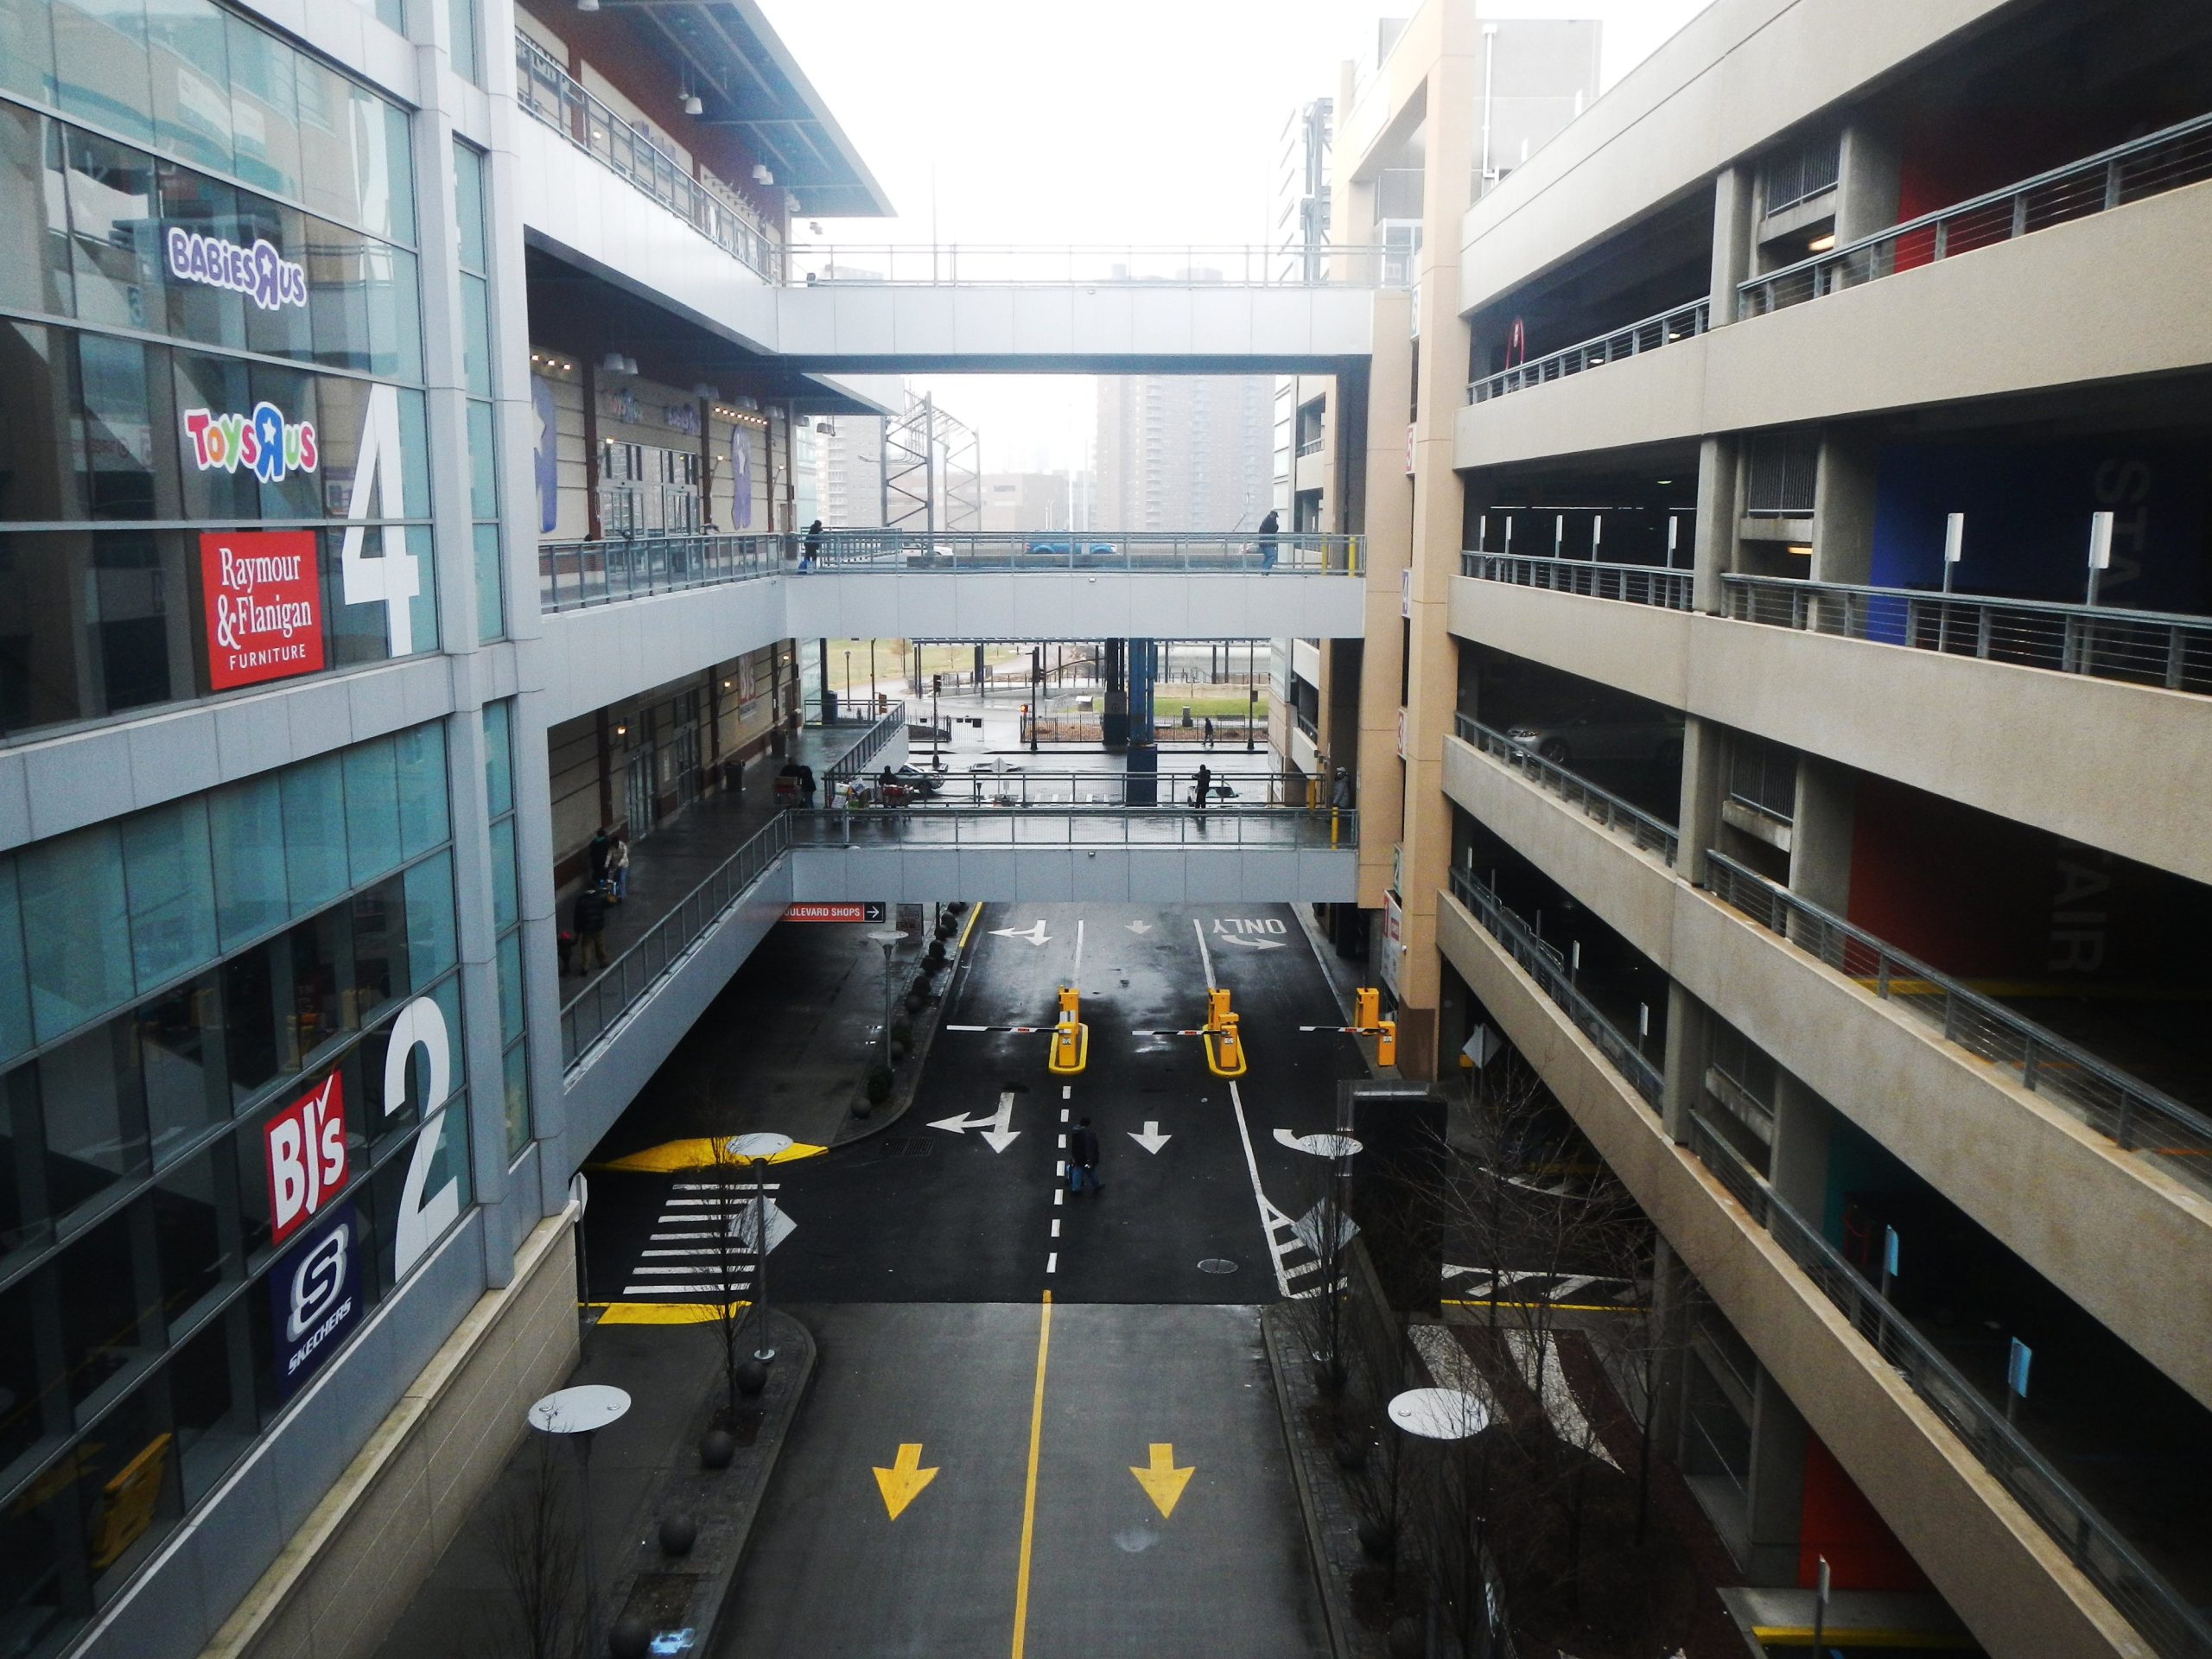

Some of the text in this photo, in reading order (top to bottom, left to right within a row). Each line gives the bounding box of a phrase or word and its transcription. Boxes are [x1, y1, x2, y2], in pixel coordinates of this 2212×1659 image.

[341, 384, 420, 658] 4
[219, 548, 301, 593] Raymour
[230, 644, 306, 671] FURNITURE
[784, 907, 861, 917] OULEVARD SHOPS
[1212, 918, 1287, 934] ONLY
[2048, 841, 2112, 973] AIR
[385, 996, 459, 1283] 2
[288, 1297, 352, 1375] SKECHERS
